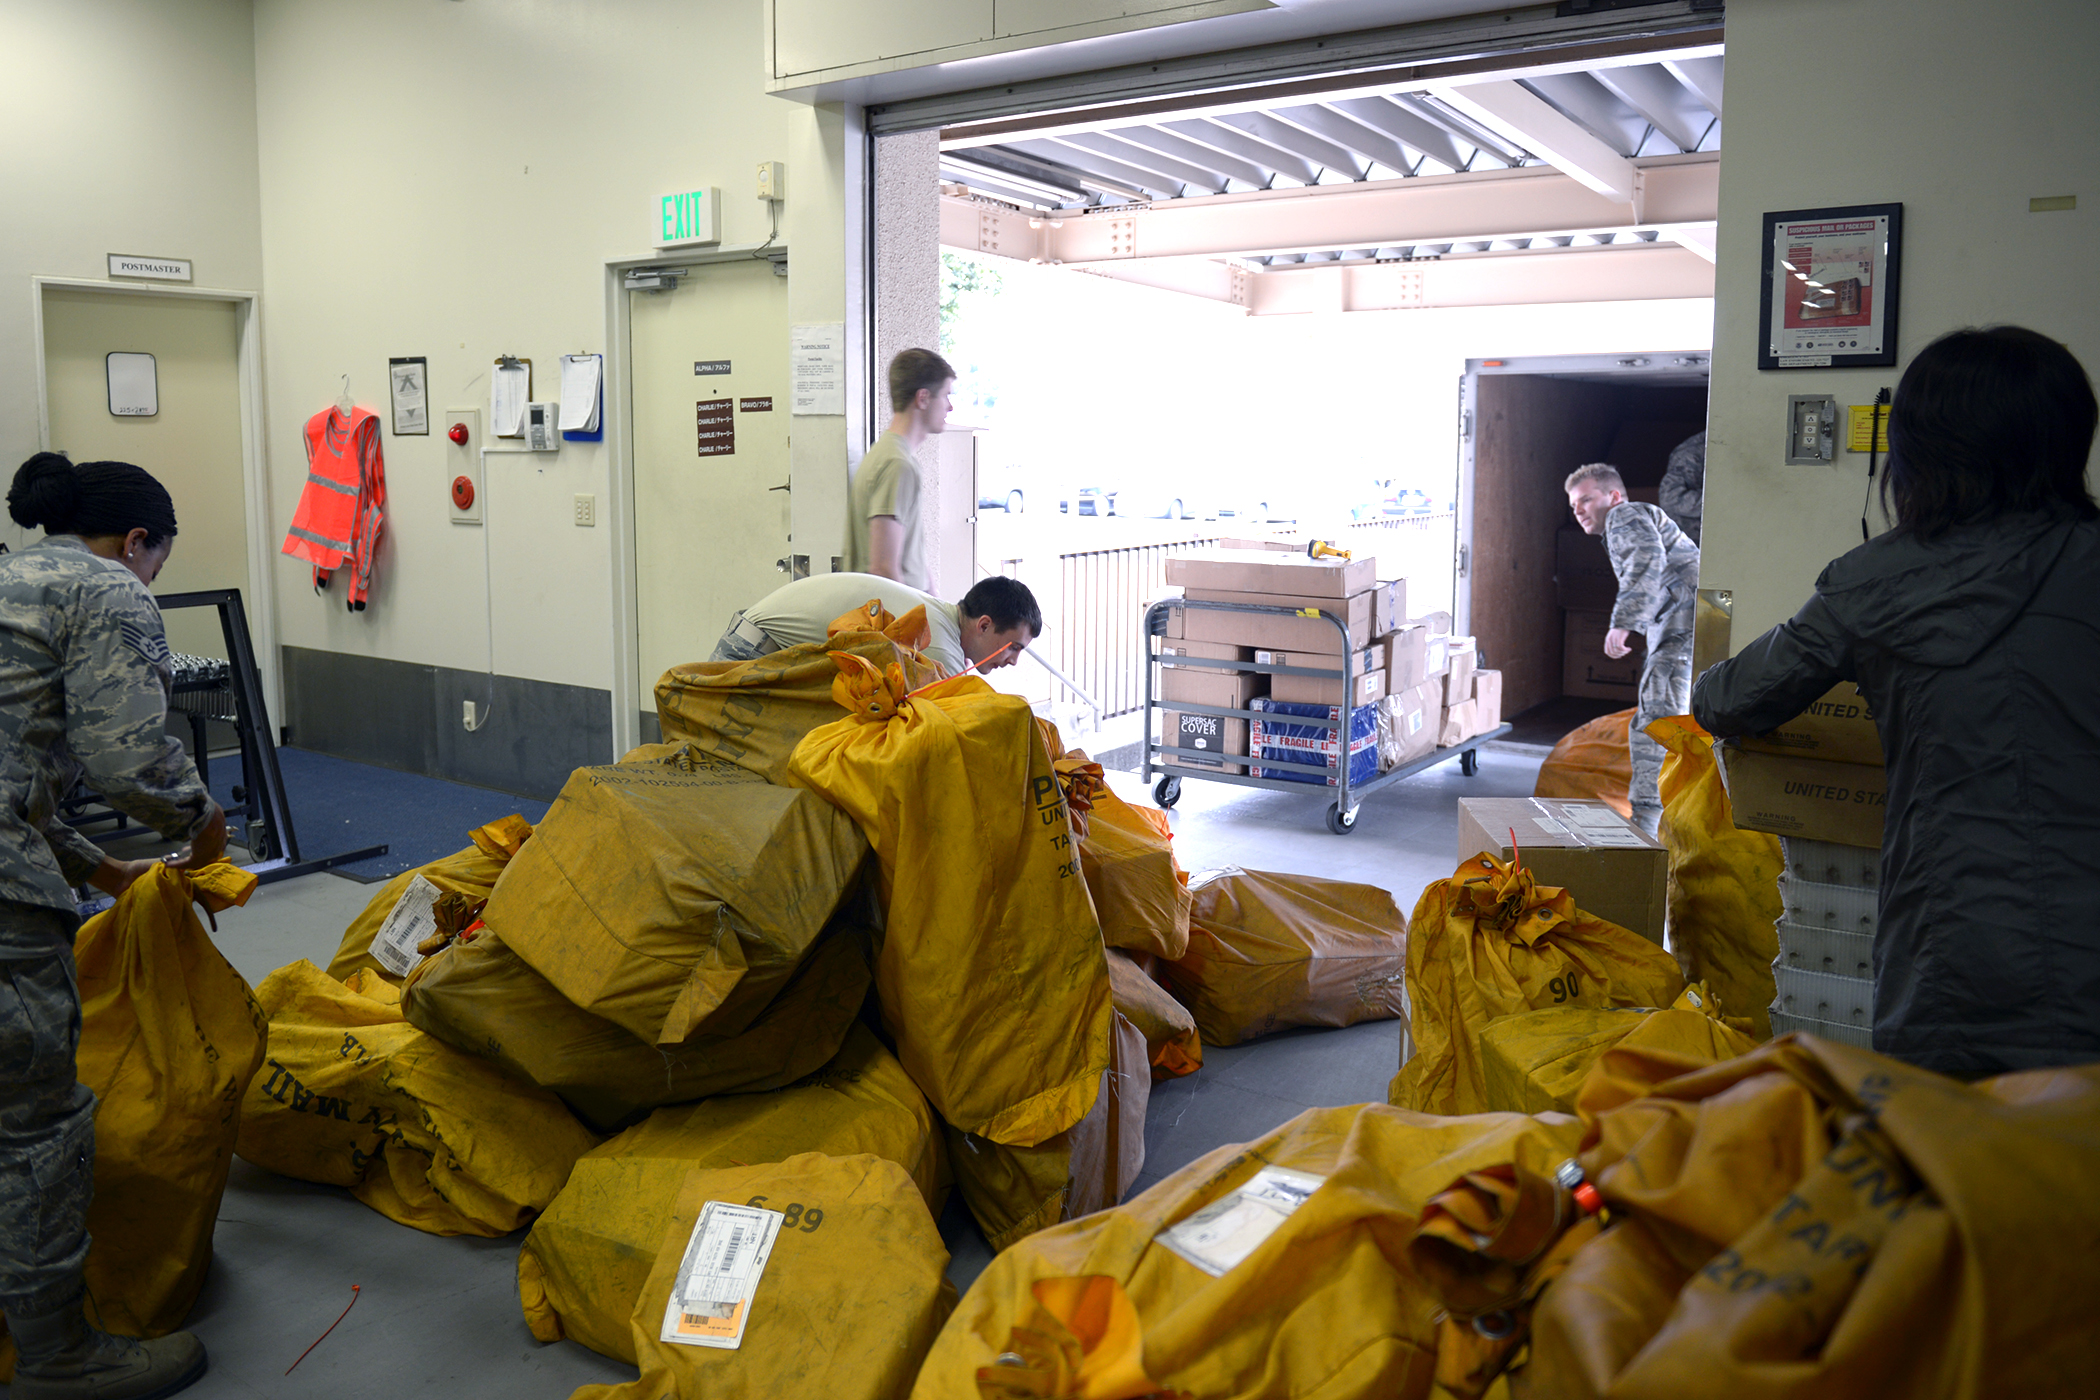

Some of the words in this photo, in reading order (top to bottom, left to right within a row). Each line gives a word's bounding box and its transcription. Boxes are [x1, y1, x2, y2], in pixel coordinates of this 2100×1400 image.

[662, 191, 702, 241] EXIT
[1789, 225, 1820, 234] SUSPICIOUS
[1821, 224, 1835, 232] MAIL
[1845, 222, 1874, 231] PACKAGES
[121, 262, 181, 273] POSTMASTER
[1803, 701, 1859, 719] NITED
[1181, 715, 1217, 726] SUPERSAC
[1329, 707, 1339, 745] FRAILE
[1181, 723, 1216, 736] COVER
[1280, 736, 1314, 749] FRAGILE
[1784, 781, 1849, 801] UNITED
[1756, 811, 1796, 822] WARNING
[1549, 971, 1579, 1004] 90
[261, 1058, 352, 1122] MAIL
